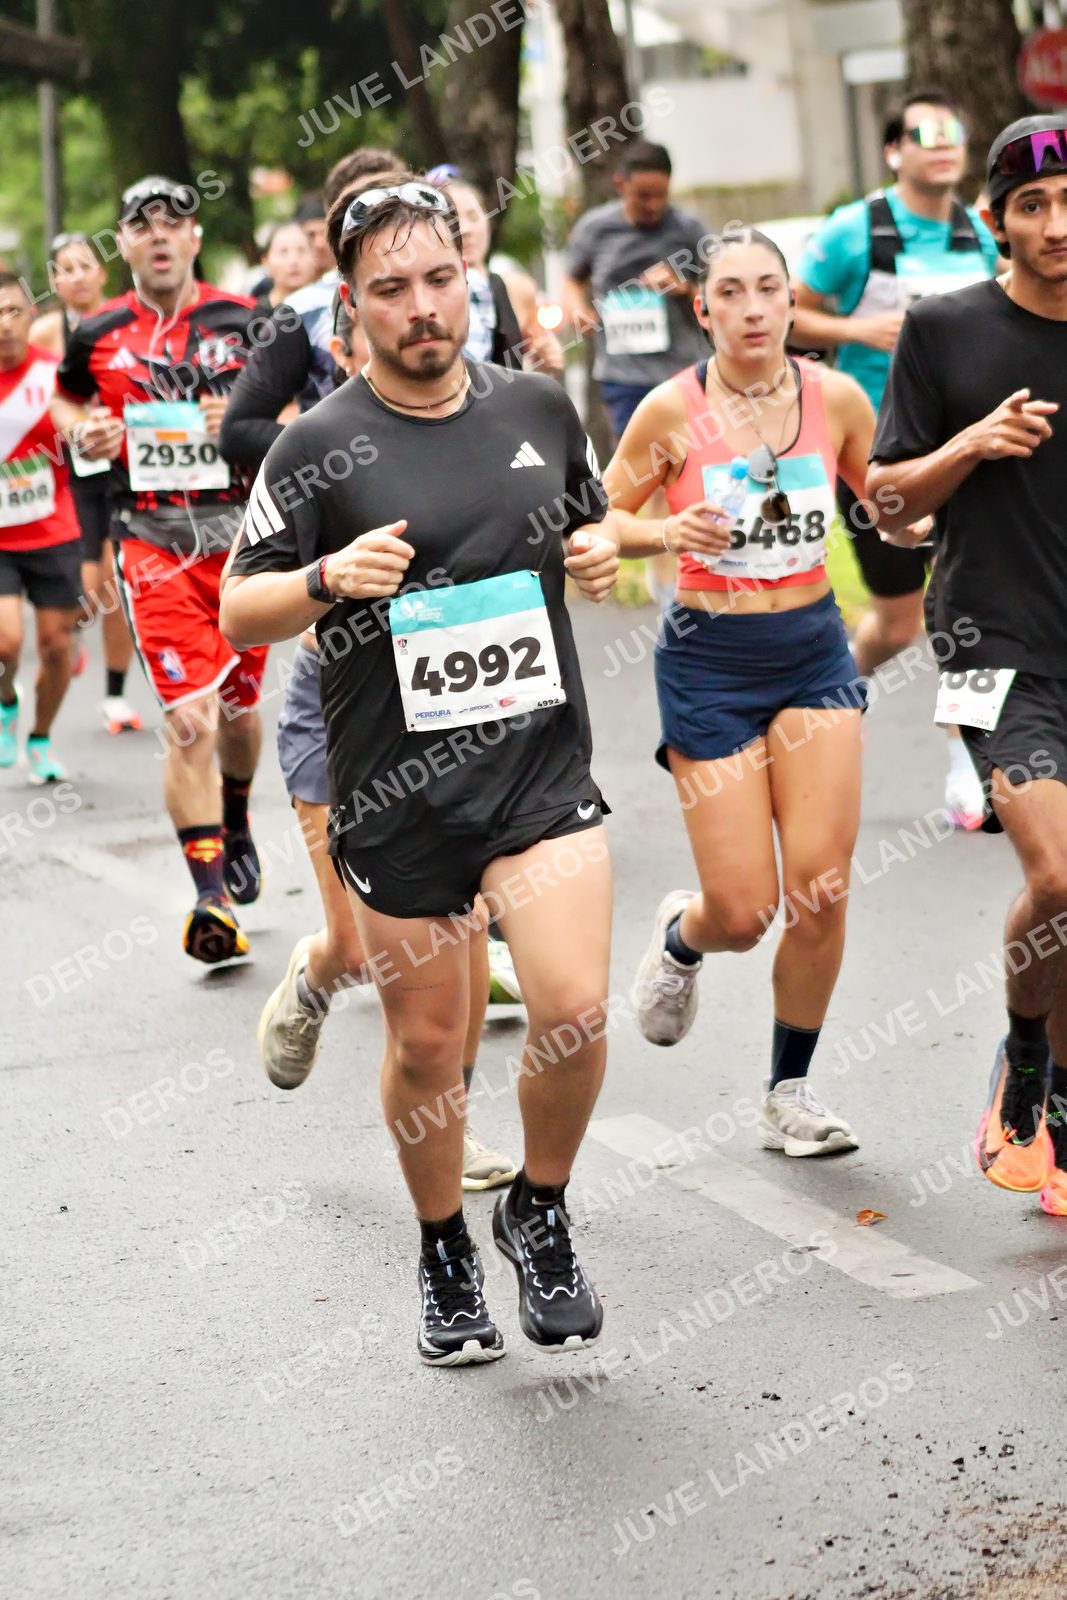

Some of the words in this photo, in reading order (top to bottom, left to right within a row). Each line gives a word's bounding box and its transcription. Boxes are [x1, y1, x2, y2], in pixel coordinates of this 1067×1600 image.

[138, 443, 217, 467] 2930
[411, 636, 546, 697] 4992
[537, 698, 560, 708] 4992
[415, 709, 452, 719] PERDURA
